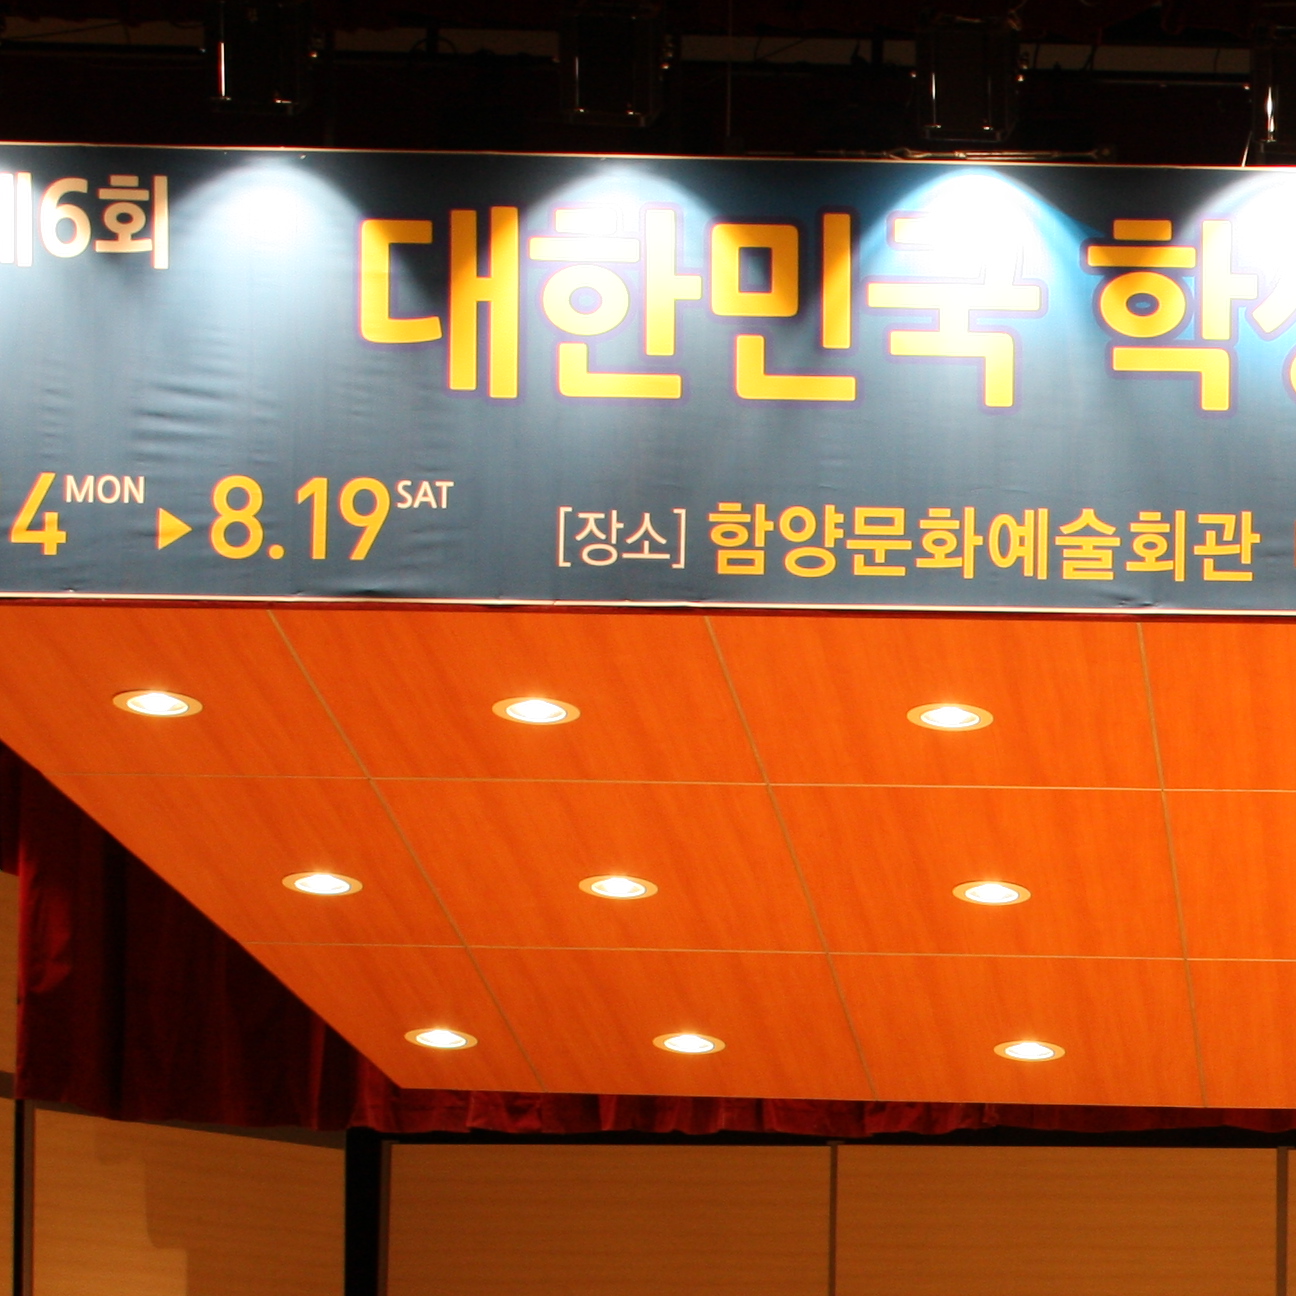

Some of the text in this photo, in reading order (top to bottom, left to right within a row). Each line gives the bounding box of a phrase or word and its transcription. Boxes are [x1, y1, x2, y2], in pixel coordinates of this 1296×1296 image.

[359, 206, 1042, 408] 대한민국
[65, 474, 146, 504] MON
[209, 474, 391, 561] 8.19
[396, 480, 455, 509] SAT
[557, 506, 687, 569] [장소]
[708, 502, 1261, 583] 함양문화예술회관
